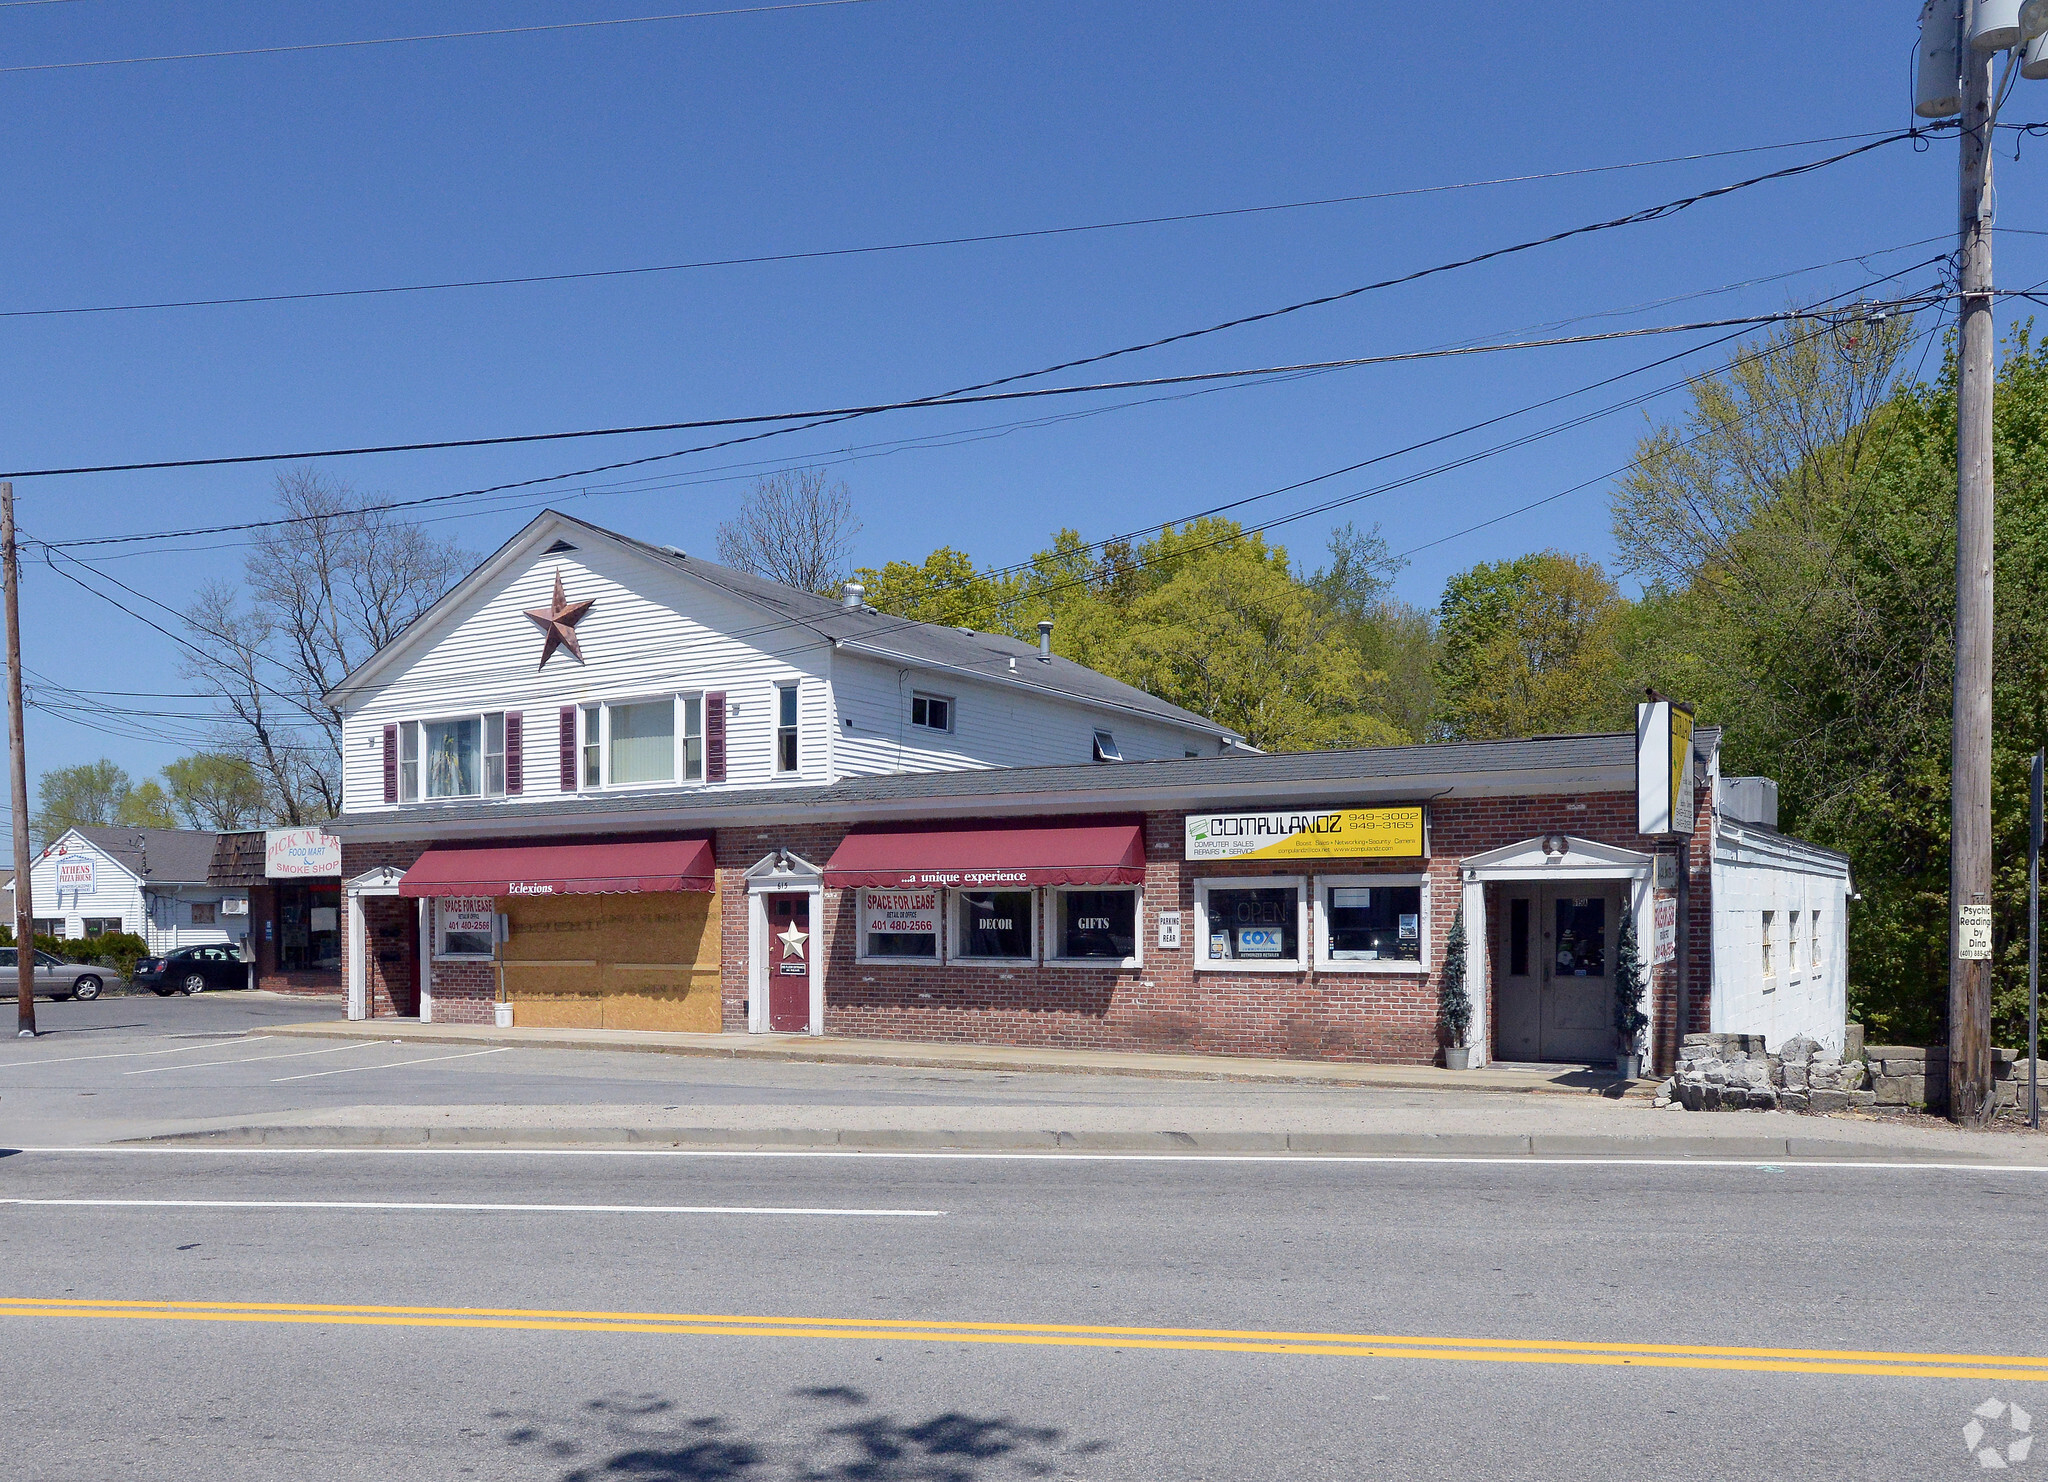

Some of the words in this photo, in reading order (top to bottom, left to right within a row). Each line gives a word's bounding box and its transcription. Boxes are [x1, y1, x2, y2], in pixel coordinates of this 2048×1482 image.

[1349, 812, 1418, 820] 949-3002
[1211, 815, 1342, 836] COMPULANDZ
[1350, 821, 1414, 829] 949-3165
[1368, 838, 1392, 846] Security
[267, 833, 297, 862] PICK
[288, 848, 307, 856] FOOD
[308, 847, 326, 856] MART
[304, 856, 315, 865] &
[61, 865, 90, 874] ATHENS
[276, 862, 310, 874] SMOKE
[312, 860, 339, 873] SHOP
[60, 874, 75, 882] PIZZA
[75, 873, 92, 882] HOUSE
[921, 871, 960, 884] unique
[964, 870, 1027, 884] experience
[509, 882, 553, 894] Eclexions
[444, 899, 462, 913] SPACE
[463, 899, 474, 912] FOR
[474, 899, 492, 912] LEASE
[867, 894, 893, 910] SPACE
[893, 894, 910, 910] FOR
[910, 894, 935, 910] LEASE
[1237, 902, 1286, 922] OPEN
[1963, 906, 1990, 916] Psychic
[449, 921, 459, 930] 401
[871, 920, 887, 930] 401
[890, 920, 933, 931] 480-2566
[979, 918, 1013, 930] DECOR
[1078, 917, 1110, 929] GIFTS
[1160, 917, 1179, 925] PARKING
[1162, 934, 1176, 942] REAR
[1242, 930, 1279, 945] COX
[1973, 928, 1984, 938] by
[1969, 938, 1987, 948] Dina
